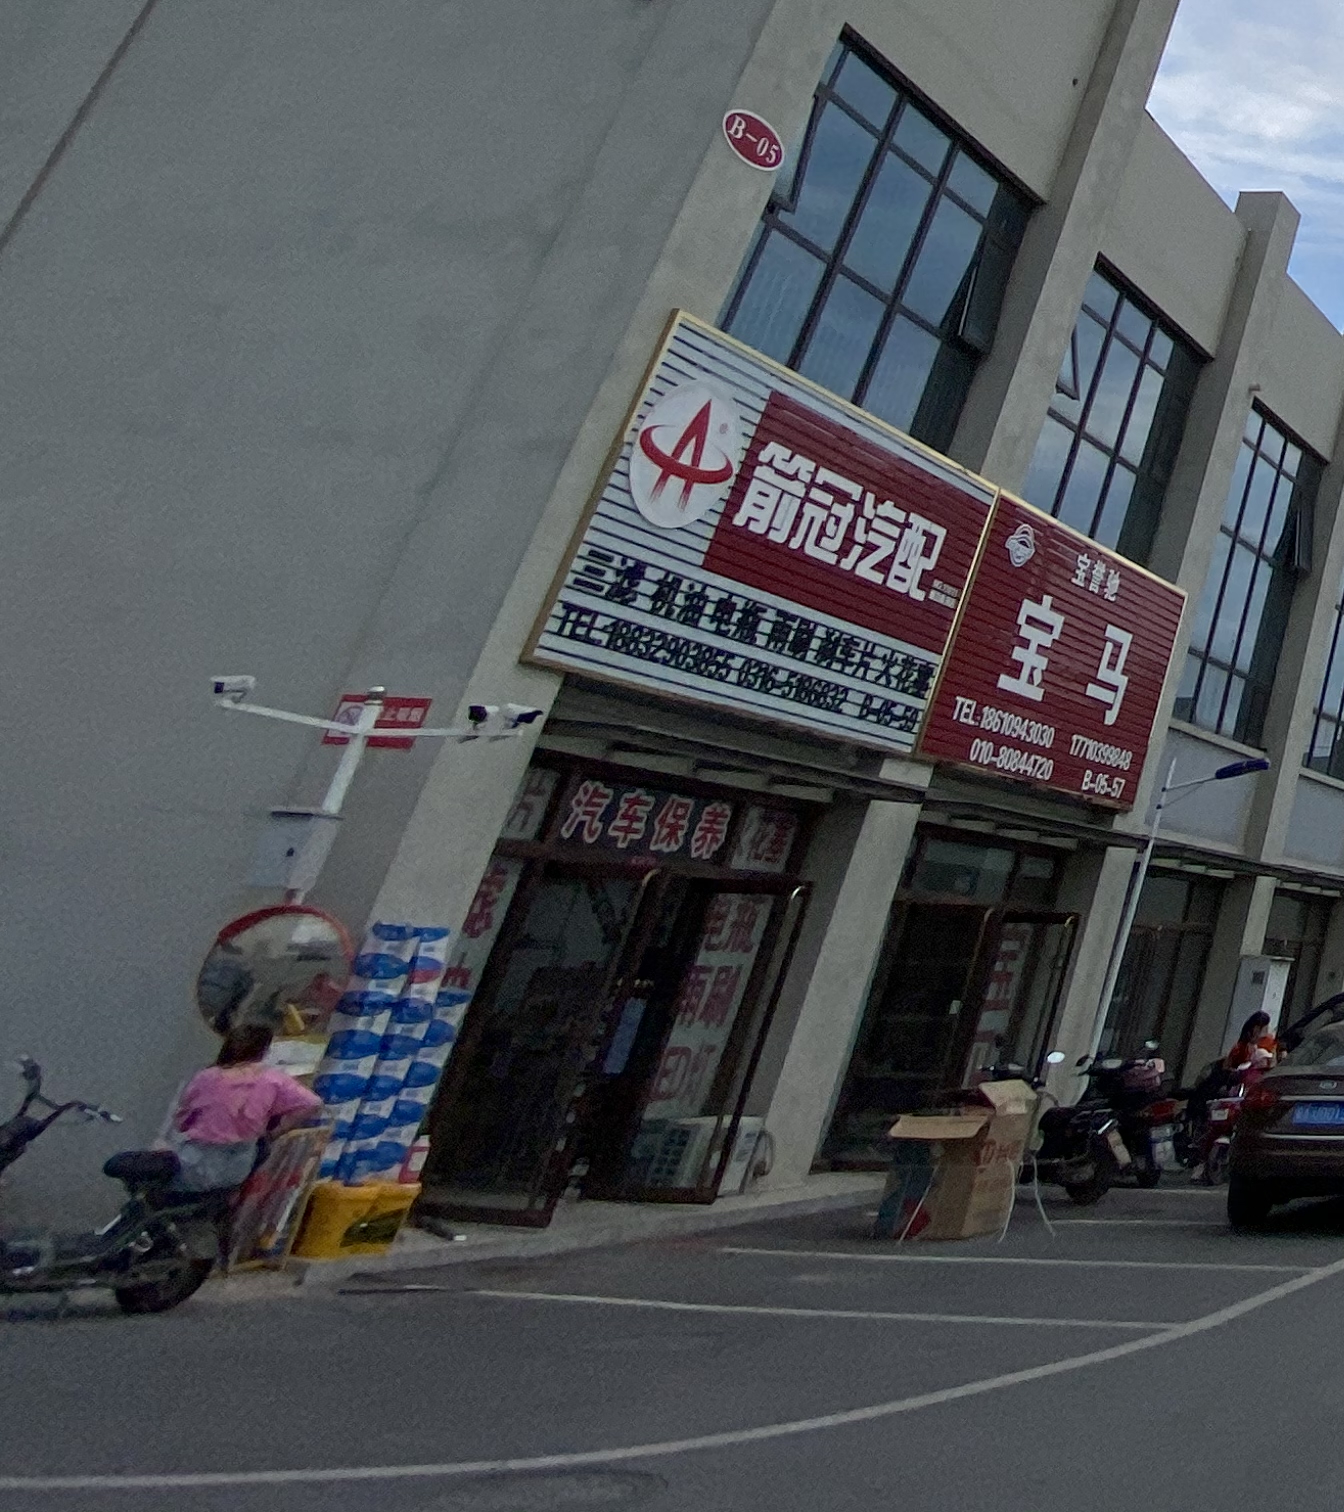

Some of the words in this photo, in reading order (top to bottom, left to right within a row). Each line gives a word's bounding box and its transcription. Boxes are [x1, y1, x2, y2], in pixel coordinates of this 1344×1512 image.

[728, 115, 779, 163] B-05
[732, 441, 947, 602] 箭冠汽配
[997, 595, 1133, 726] 宝马
[561, 779, 732, 860] 汽车保养
